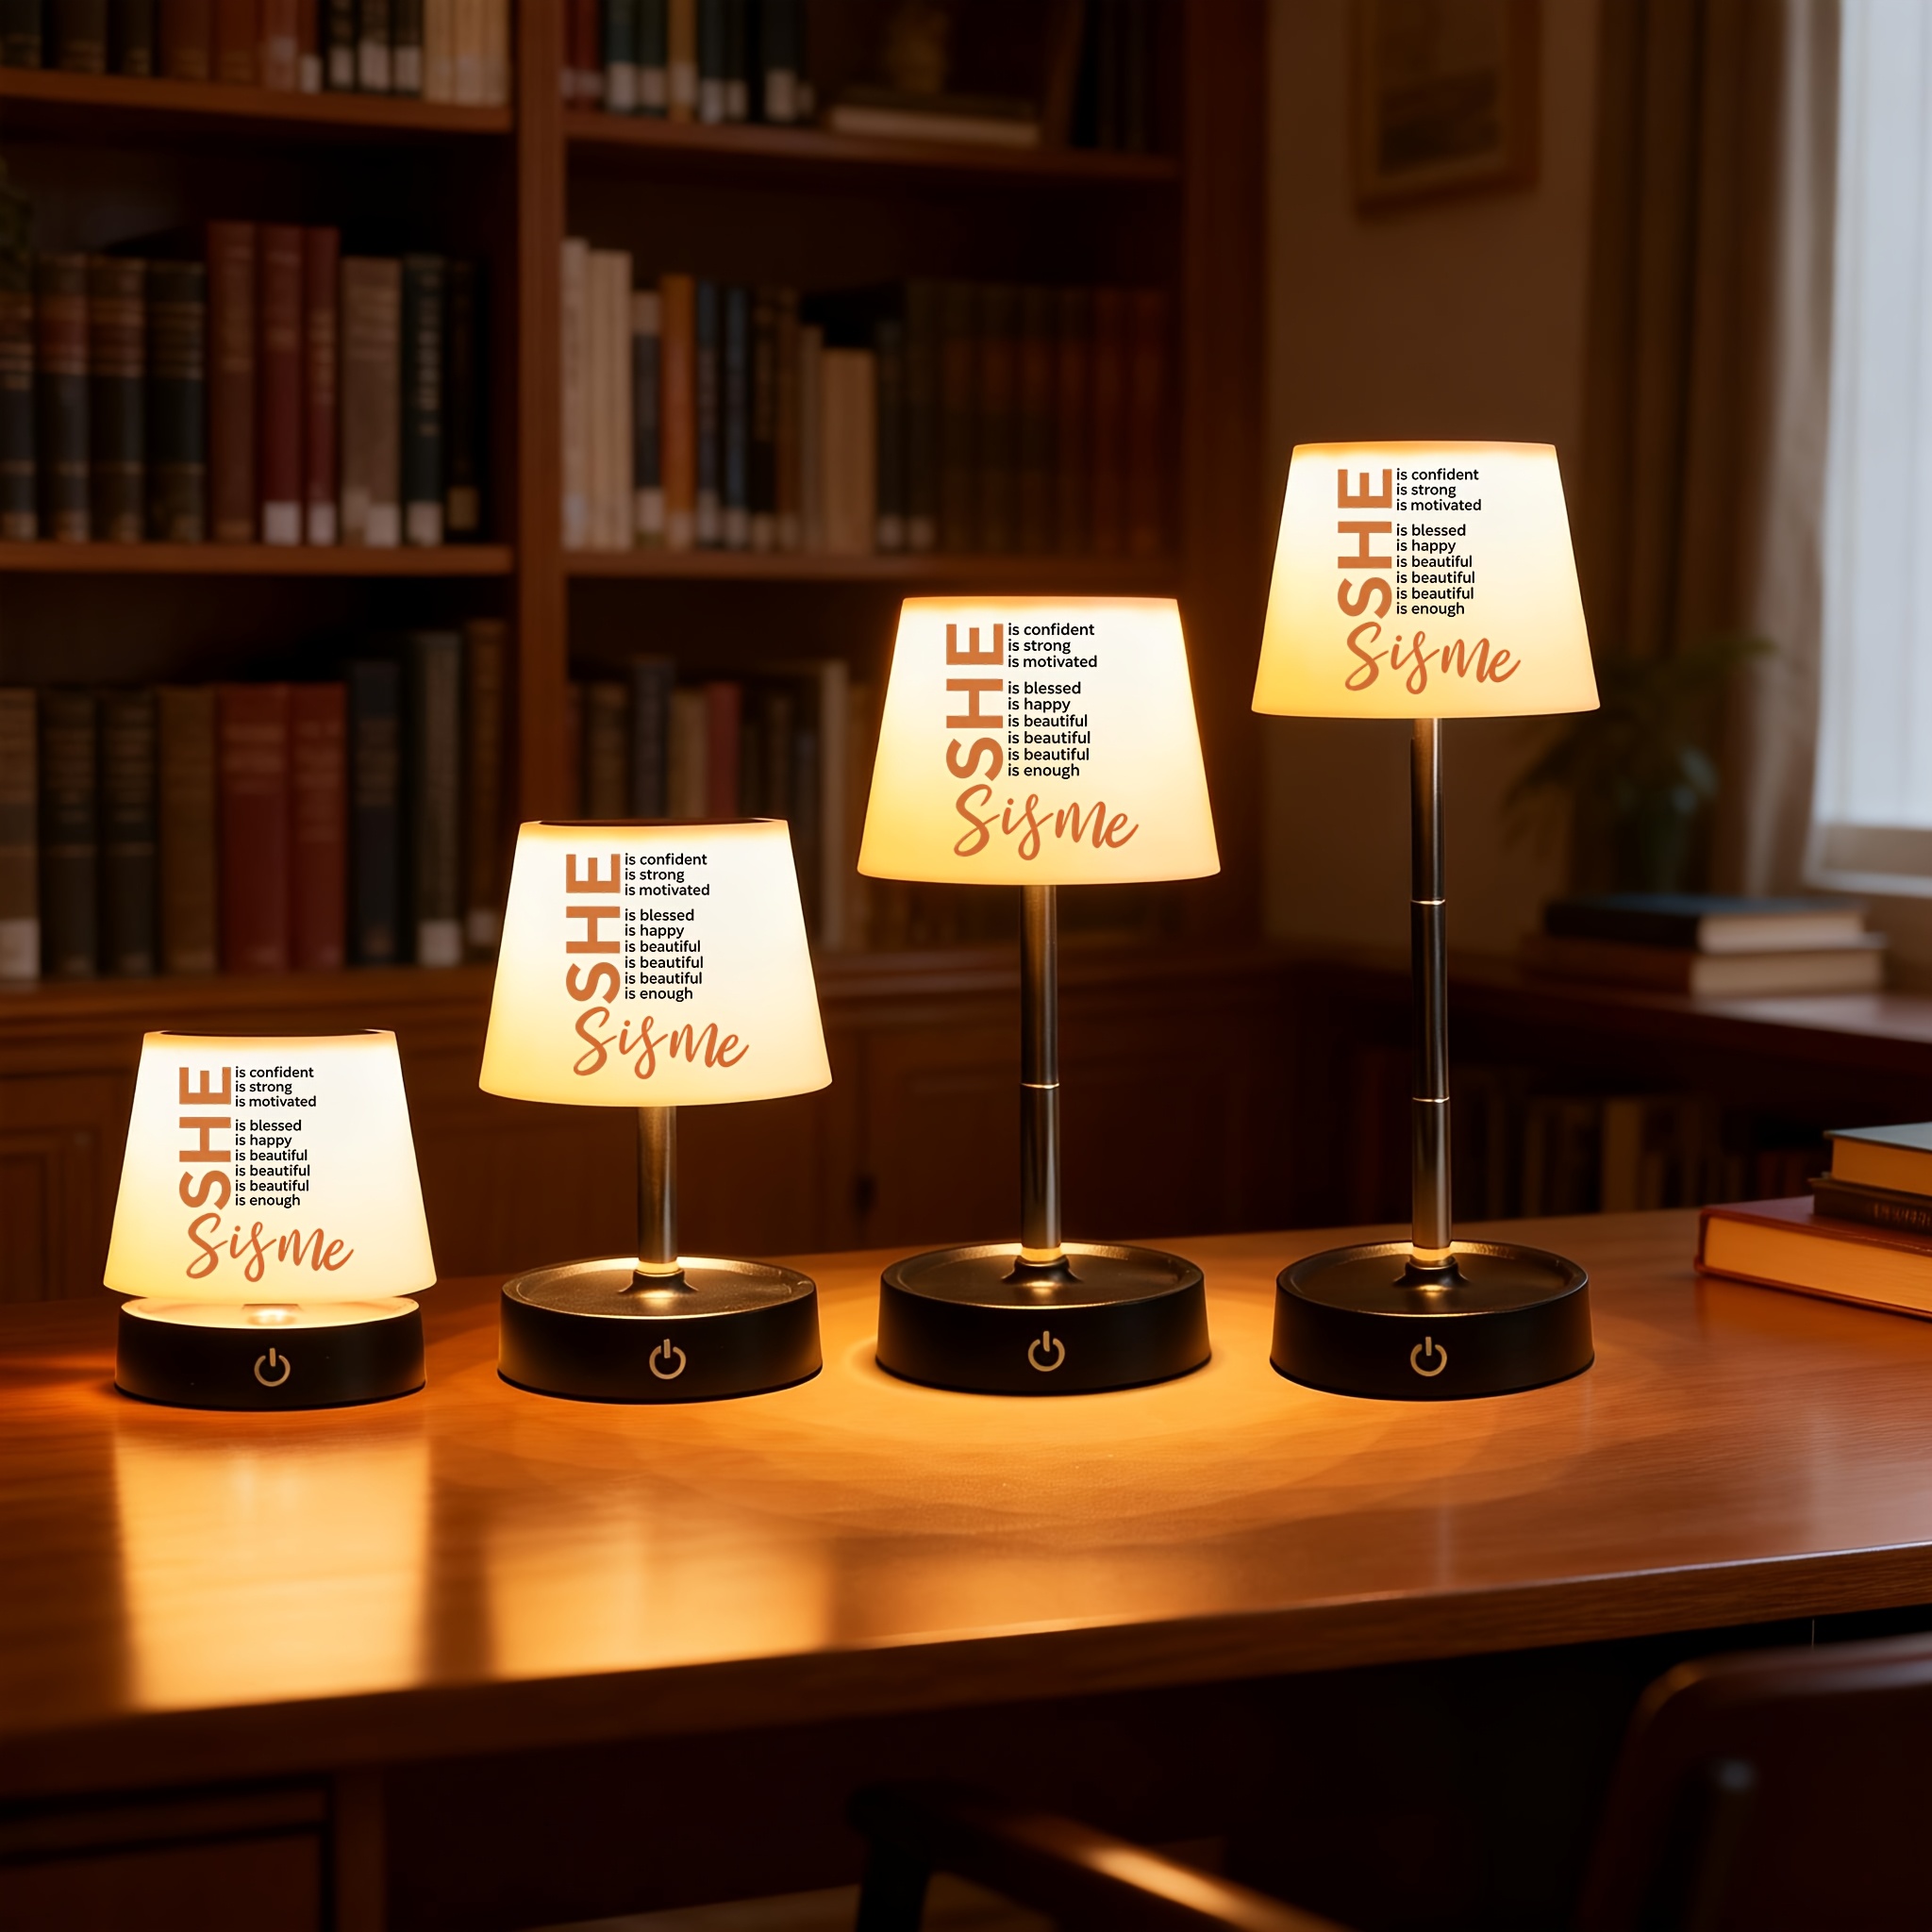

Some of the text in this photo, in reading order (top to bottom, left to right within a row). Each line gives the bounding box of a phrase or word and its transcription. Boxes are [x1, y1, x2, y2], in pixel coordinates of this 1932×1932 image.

[1396, 467, 1480, 481] is confident
[1396, 482, 1457, 499] is strong
[1396, 498, 1482, 511] is motivated
[1396, 523, 1467, 537] is blessed
[1337, 469, 1392, 619] SHE
[1396, 538, 1457, 555] is happy
[1396, 555, 1473, 568] is beautiful
[1396, 570, 1475, 584] is beautiful
[1396, 586, 1474, 600] is beautiful
[1396, 601, 1465, 618] is enough
[1008, 622, 1095, 636] is confident
[1008, 638, 1072, 655] is strong
[1008, 654, 1098, 668] is motivated
[1008, 680, 1081, 695] is blessed
[945, 624, 1004, 782] SHE
[1008, 696, 1072, 714] is happy
[1008, 713, 1088, 728] is beautiful
[1008, 730, 1091, 744] is beautiful
[1008, 747, 1090, 761] is beautiful
[1008, 762, 1080, 780] is enough
[625, 852, 708, 866] is confident
[625, 867, 685, 884] is strong
[625, 883, 710, 896] is motivated
[625, 908, 694, 922] is blessed
[565, 854, 621, 1004] SHE
[625, 923, 685, 940] is happy
[625, 939, 701, 953] is beautiful
[625, 955, 704, 969] is beautiful
[625, 971, 703, 985] is beautiful
[625, 986, 693, 1003] is enough
[235, 1065, 315, 1078] is confident
[235, 1079, 293, 1095] is strong
[235, 1094, 317, 1108] is motivated
[235, 1118, 302, 1132] is blessed
[178, 1067, 231, 1210] SHE
[235, 1133, 292, 1149] is happy
[235, 1148, 308, 1161] is beautiful
[235, 1163, 310, 1177] is beautiful
[235, 1179, 309, 1192] is beautiful
[235, 1193, 301, 1209] is enough
